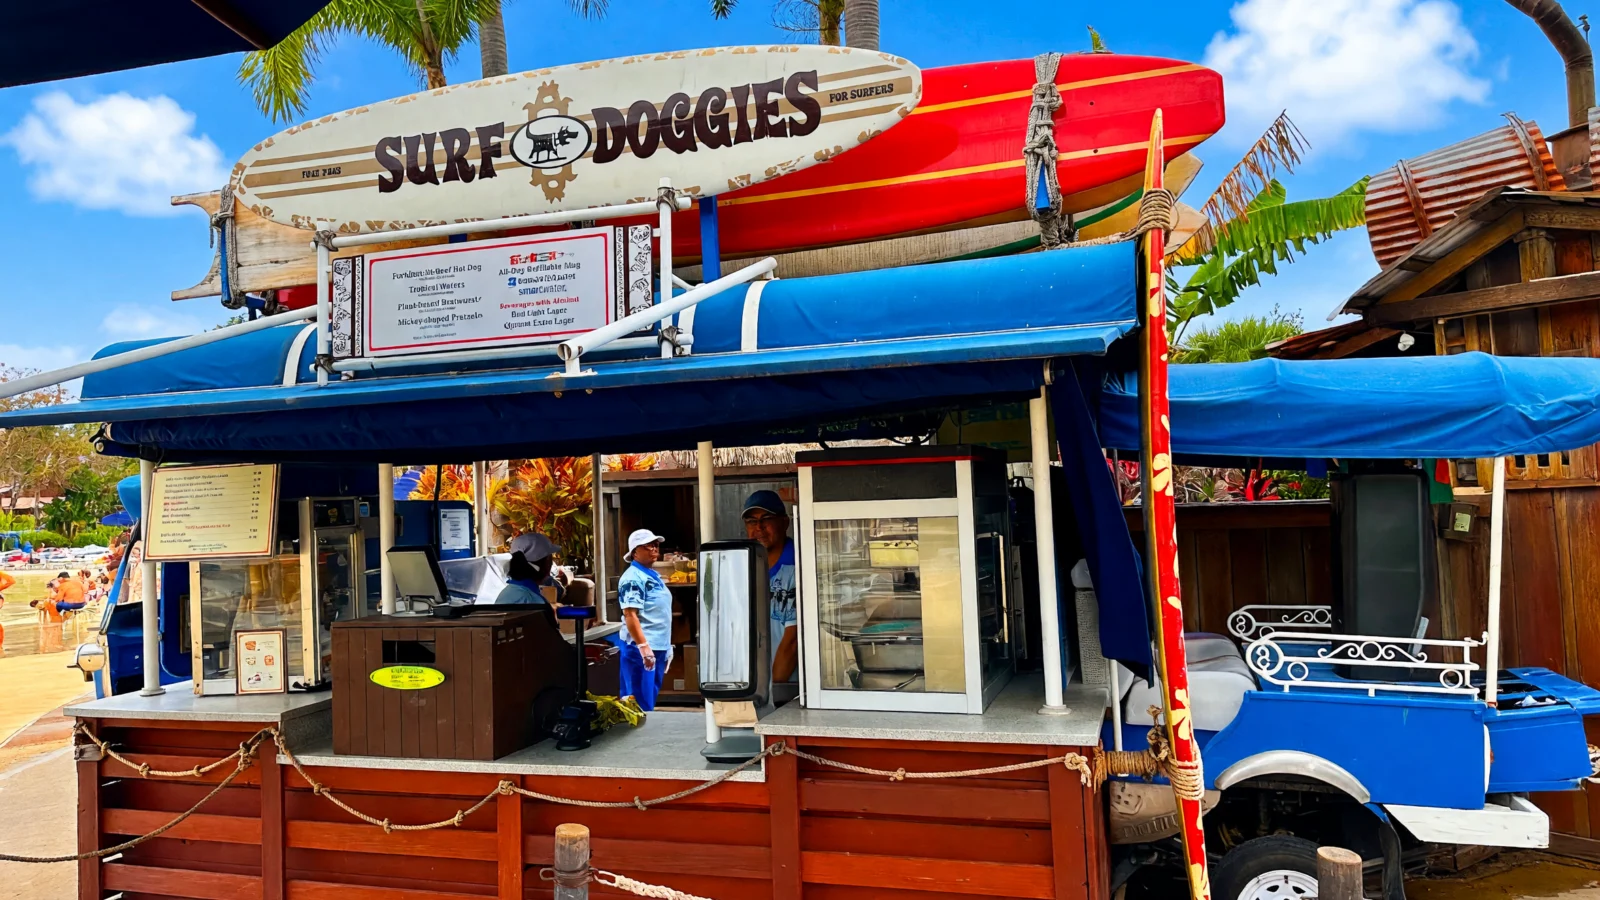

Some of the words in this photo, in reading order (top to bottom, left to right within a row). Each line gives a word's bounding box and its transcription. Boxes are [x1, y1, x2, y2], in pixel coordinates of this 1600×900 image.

[829, 91, 848, 103] FOR
[850, 83, 894, 99] SURFERS
[375, 122, 504, 193] SURF
[591, 70, 821, 164] DOGGIES
[453, 265, 466, 273] Hot
[467, 263, 482, 272] Dog
